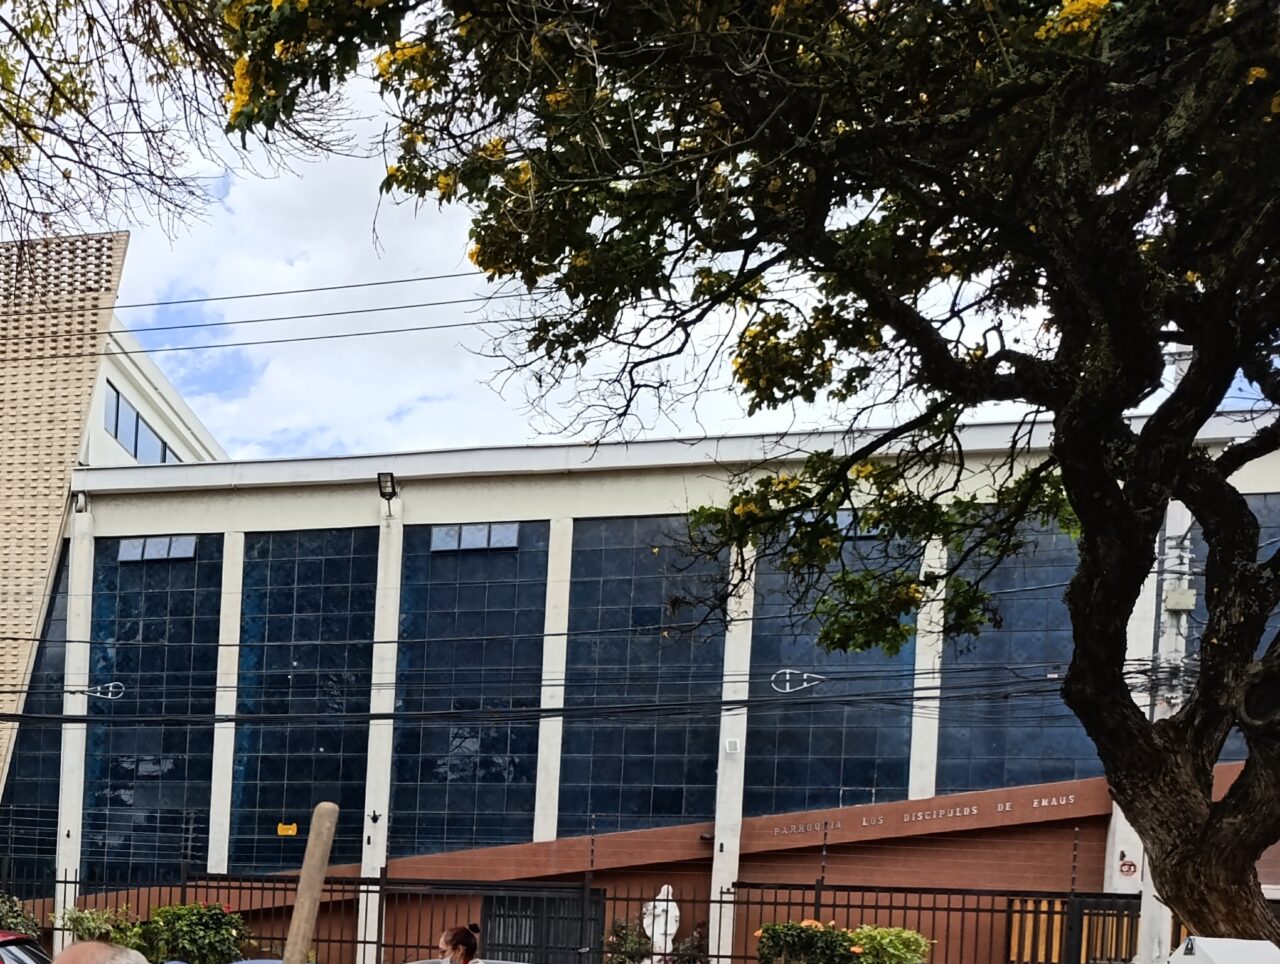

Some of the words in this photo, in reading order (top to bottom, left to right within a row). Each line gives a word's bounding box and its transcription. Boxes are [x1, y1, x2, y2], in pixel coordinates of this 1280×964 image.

[862, 816, 884, 826] LOS
[903, 806, 978, 822] DISCIPULOS
[997, 802, 1012, 812] DE
[1032, 795, 1076, 808] EMAUS
